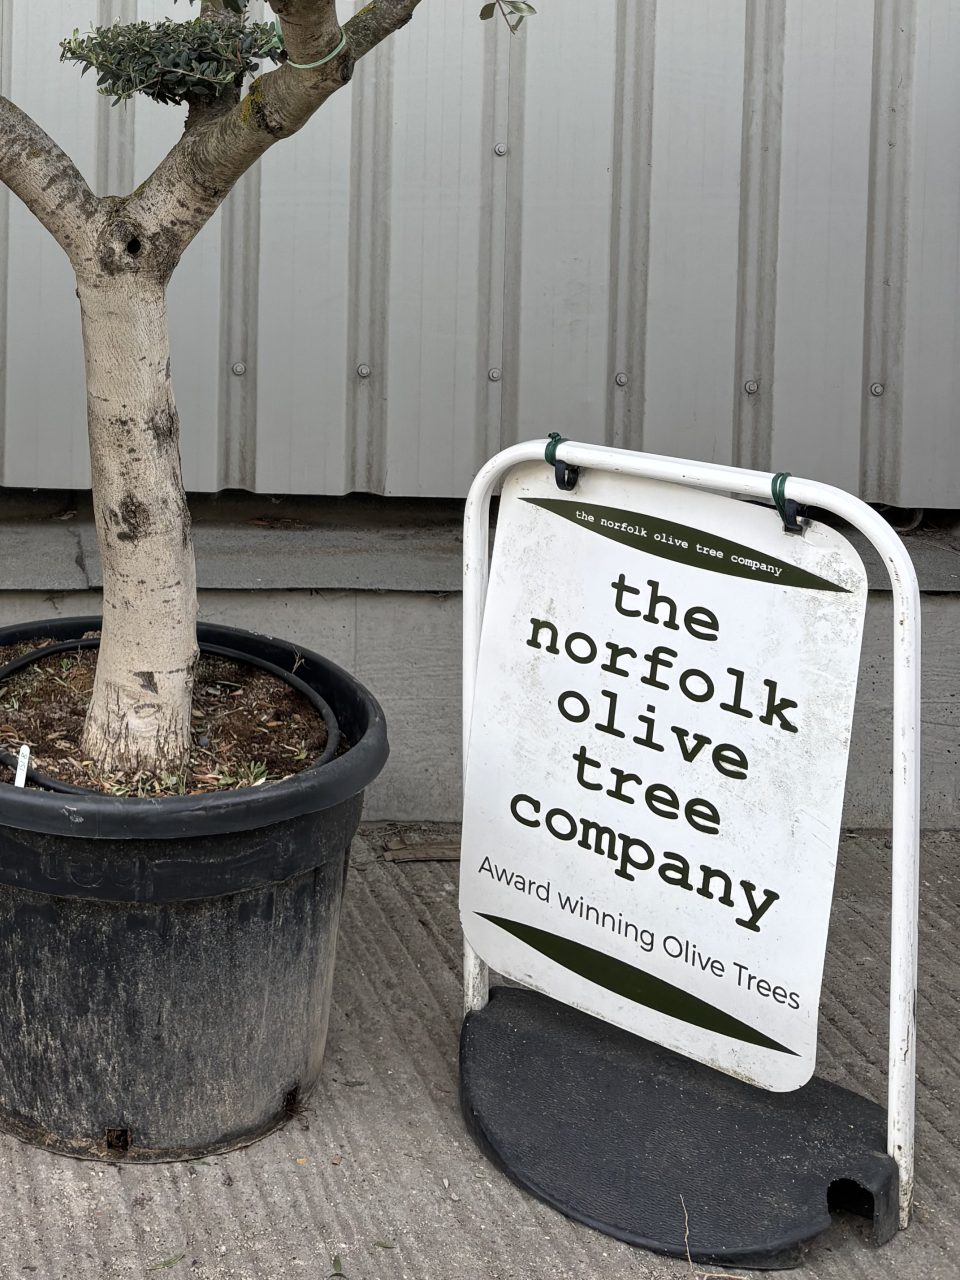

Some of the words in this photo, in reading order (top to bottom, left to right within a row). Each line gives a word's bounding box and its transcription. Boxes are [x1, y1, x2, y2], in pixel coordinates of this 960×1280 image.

[576, 510, 594, 523] the
[600, 518, 648, 538] norfolk
[653, 532, 689, 549] olive
[696, 543, 724, 559] tree
[731, 553, 783, 577] company
[611, 573, 719, 641] the
[526, 617, 799, 733] norfolk
[557, 690, 749, 780] olive
[572, 745, 721, 835] tree
[510, 793, 780, 933] company
[478, 856, 551, 903] Award
[557, 891, 655, 952] winning
[663, 935, 725, 977] Olive
[733, 962, 800, 1010] Trees
